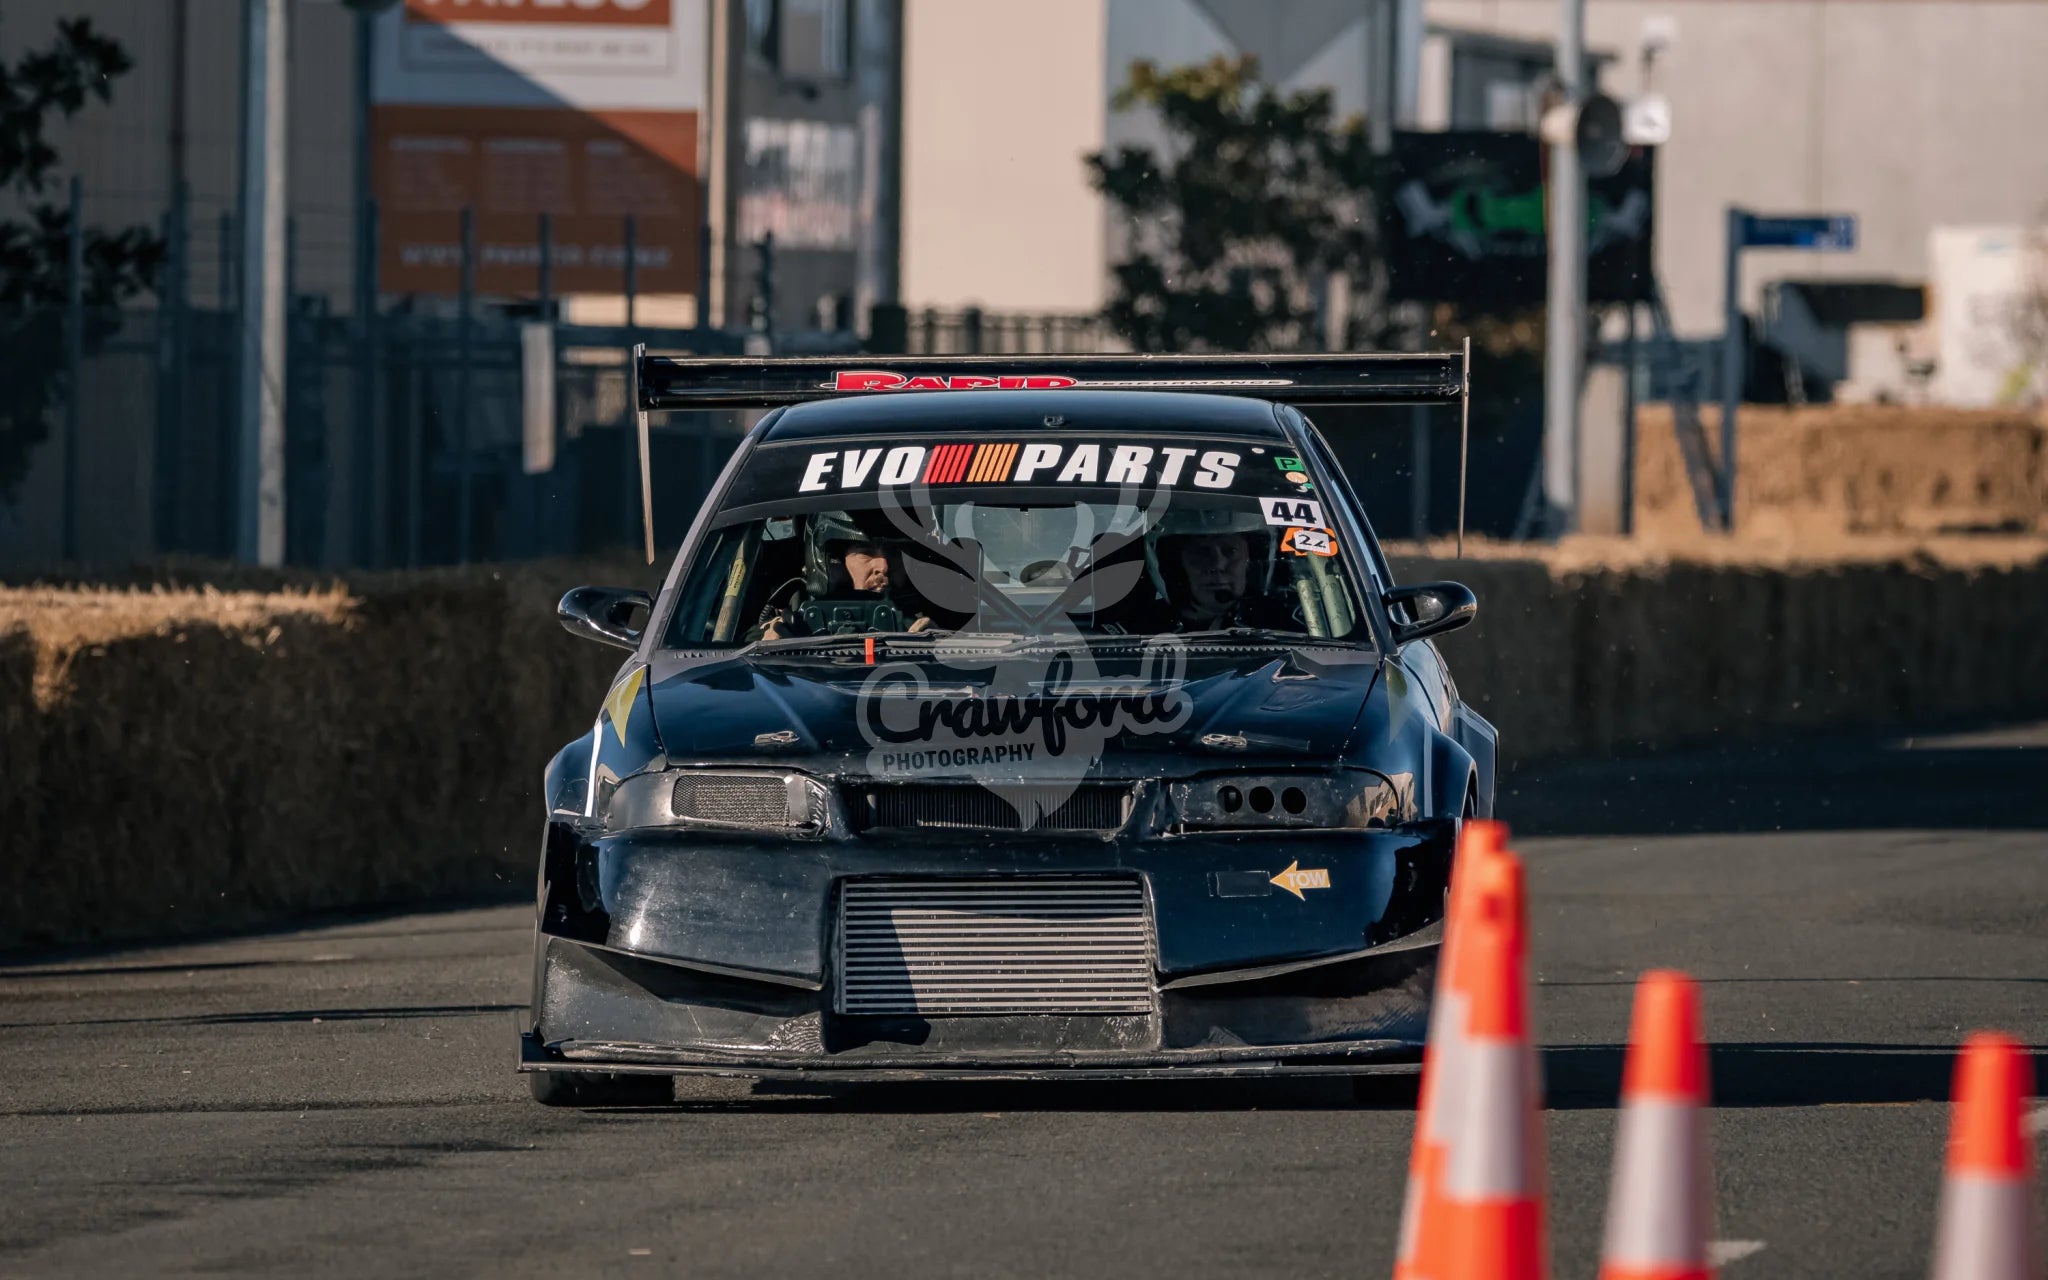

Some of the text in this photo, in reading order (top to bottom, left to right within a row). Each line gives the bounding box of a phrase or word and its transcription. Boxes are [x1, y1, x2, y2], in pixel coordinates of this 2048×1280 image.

[836, 371, 1077, 391] RAPID
[799, 443, 1241, 492] EVO PARTS
[1280, 459, 1297, 469] P
[1271, 501, 1317, 524] 44
[1287, 870, 1327, 888] TOW
